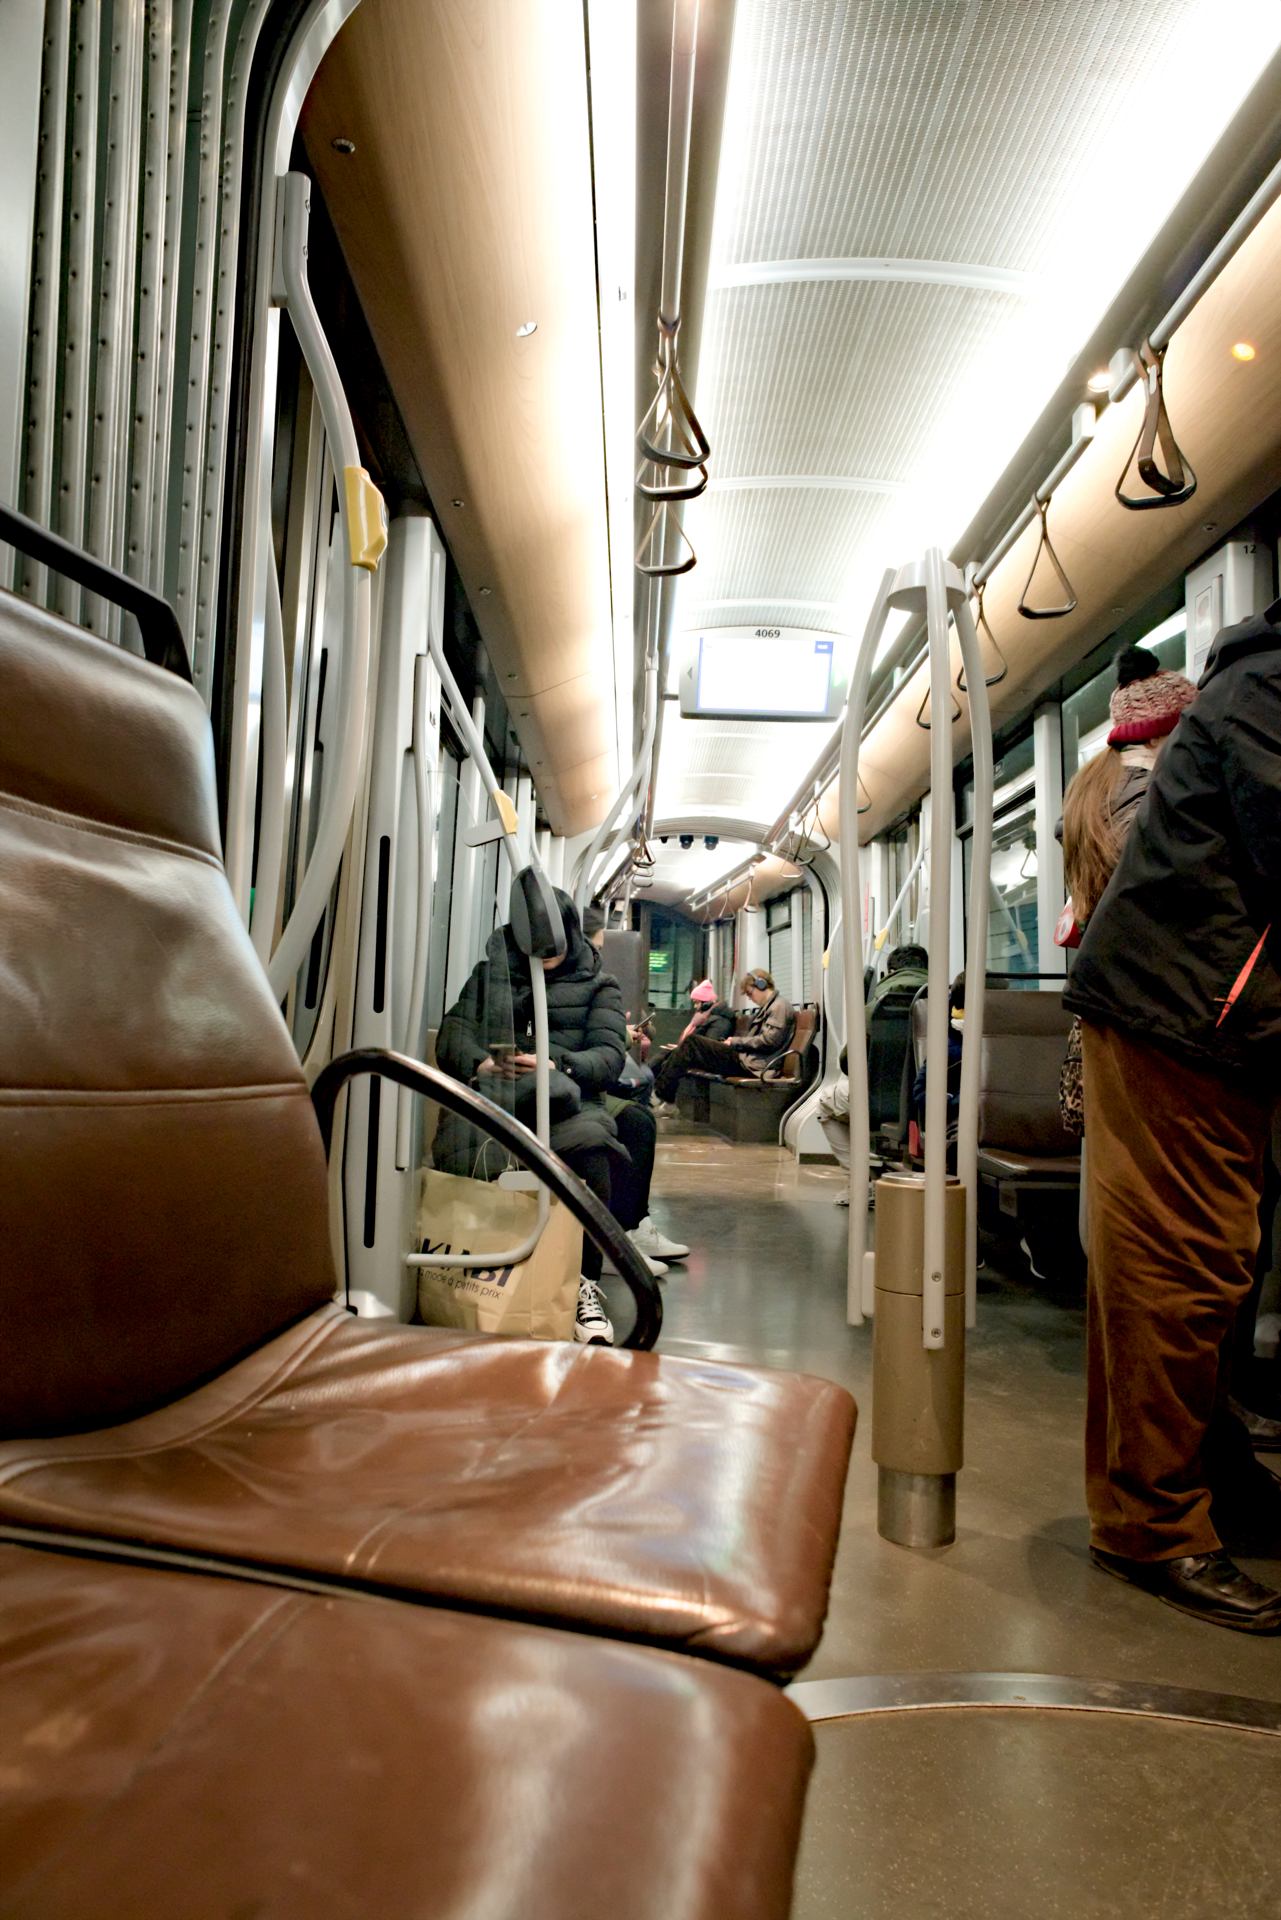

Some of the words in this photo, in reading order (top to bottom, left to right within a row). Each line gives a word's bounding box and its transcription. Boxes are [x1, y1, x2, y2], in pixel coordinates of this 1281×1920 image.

[1243, 544, 1257, 554] 12
[755, 629, 781, 639] 4069
[480, 1286, 502, 1299] prix
